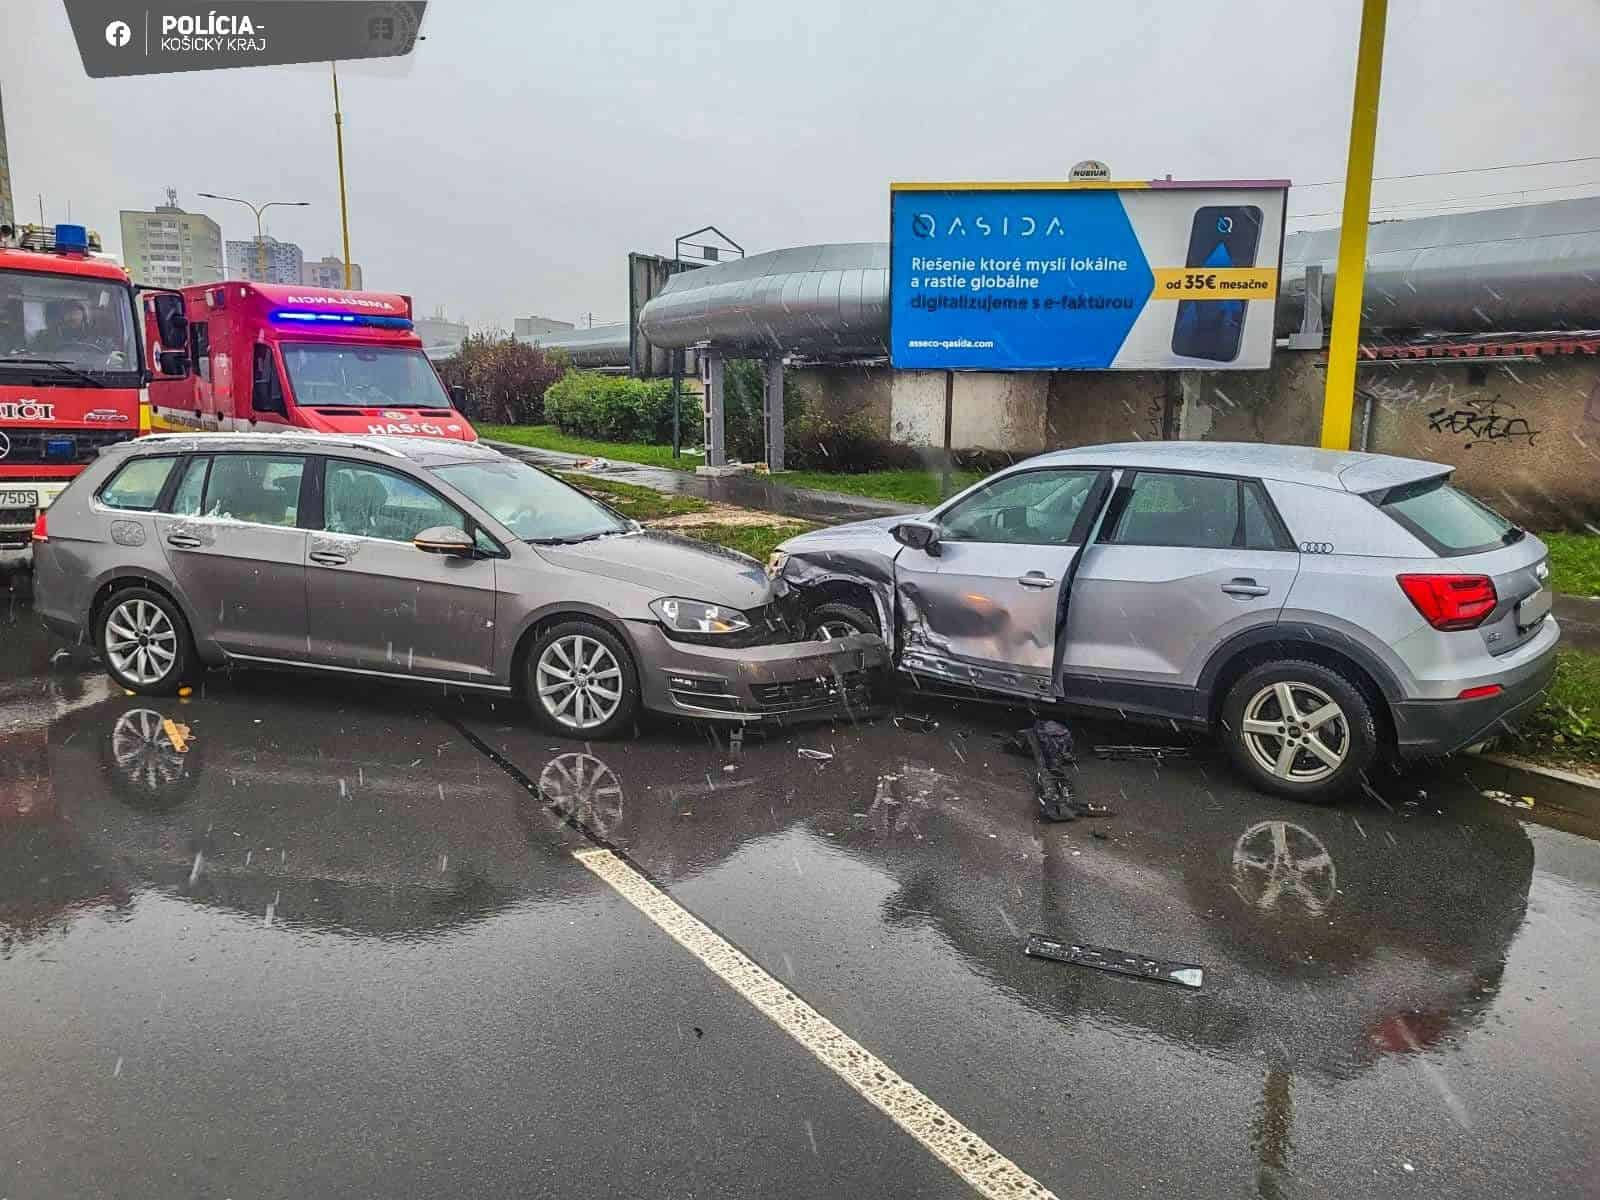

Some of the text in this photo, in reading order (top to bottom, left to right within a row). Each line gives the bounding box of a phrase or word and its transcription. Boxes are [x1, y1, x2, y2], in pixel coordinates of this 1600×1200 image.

[1073, 169, 1107, 177] NUBIUM
[912, 213, 1065, 238] QASIDA
[912, 256, 1128, 274] Riešenie ktoré myslí lokálne
[911, 274, 1039, 291] a rastie globálne
[1166, 275, 1269, 289] od 35€ mesačne
[911, 294, 1133, 312] digitalizujeme s e-faktúrou
[908, 338, 993, 350] asseco-qasida.com
[0, 398, 55, 421] IČI
